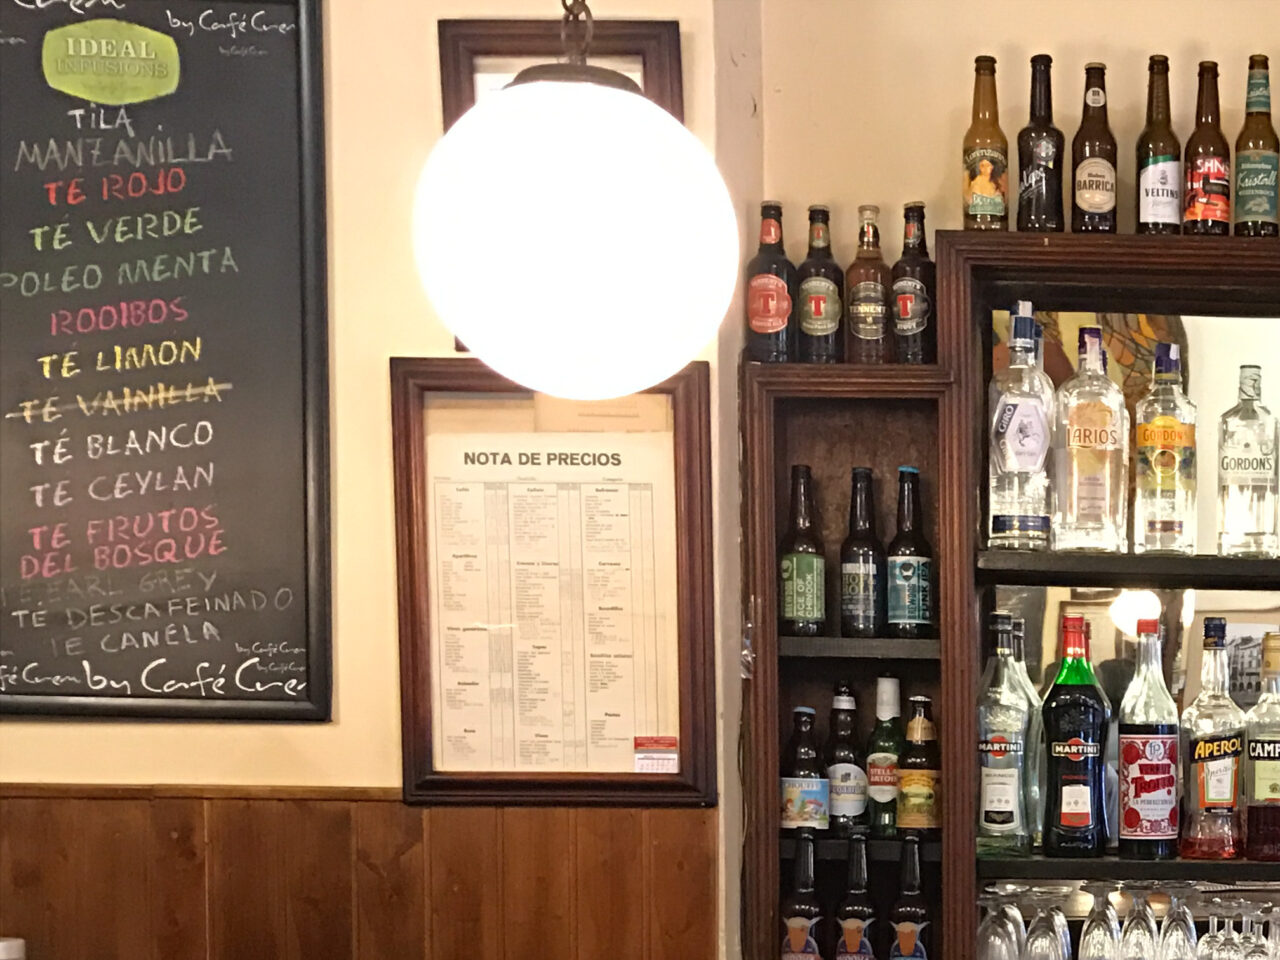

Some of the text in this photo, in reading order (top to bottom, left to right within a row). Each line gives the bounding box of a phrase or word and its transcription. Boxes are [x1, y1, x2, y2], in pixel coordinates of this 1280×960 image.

[165, 9, 194, 36] by
[198, 9, 246, 38] Café
[66, 37, 157, 60] IDEAL
[55, 58, 169, 79] INFUSIONS
[14, 125, 233, 171] MANZANILLA
[102, 167, 187, 201] ROJO
[1077, 179, 1115, 193] BARRICA
[1145, 187, 1179, 199] VELTINS
[86, 207, 203, 244] VERDE
[118, 247, 239, 285] MENTA
[50, 298, 189, 336] ROOIBOS
[758, 293, 777, 317] T
[807, 295, 827, 318] T
[896, 294, 915, 318] T
[76, 377, 223, 416] VAINILLA
[30, 421, 213, 466] TÉ BLANCO
[1067, 428, 1118, 449] LARIOS
[1143, 428, 1186, 442] GORDON
[464, 452, 621, 467] NOTA DE PRECIOS
[1221, 455, 1272, 471] GORDON'S
[88, 462, 214, 502] CEYLAN
[86, 504, 218, 544] FRUTOS
[21, 529, 228, 580] DEL BOSQUE
[138, 567, 217, 595] GREY
[805, 573, 813, 618] CHINOOK
[66, 587, 294, 631] DESCAFEINADO
[797, 578, 805, 617] ACE OF
[100, 621, 222, 652] CANELA
[82, 657, 307, 696] by Café Cre
[979, 743, 1021, 751] MARTINI
[1055, 745, 1098, 754] MARTINI
[1195, 739, 1241, 759] APEROL
